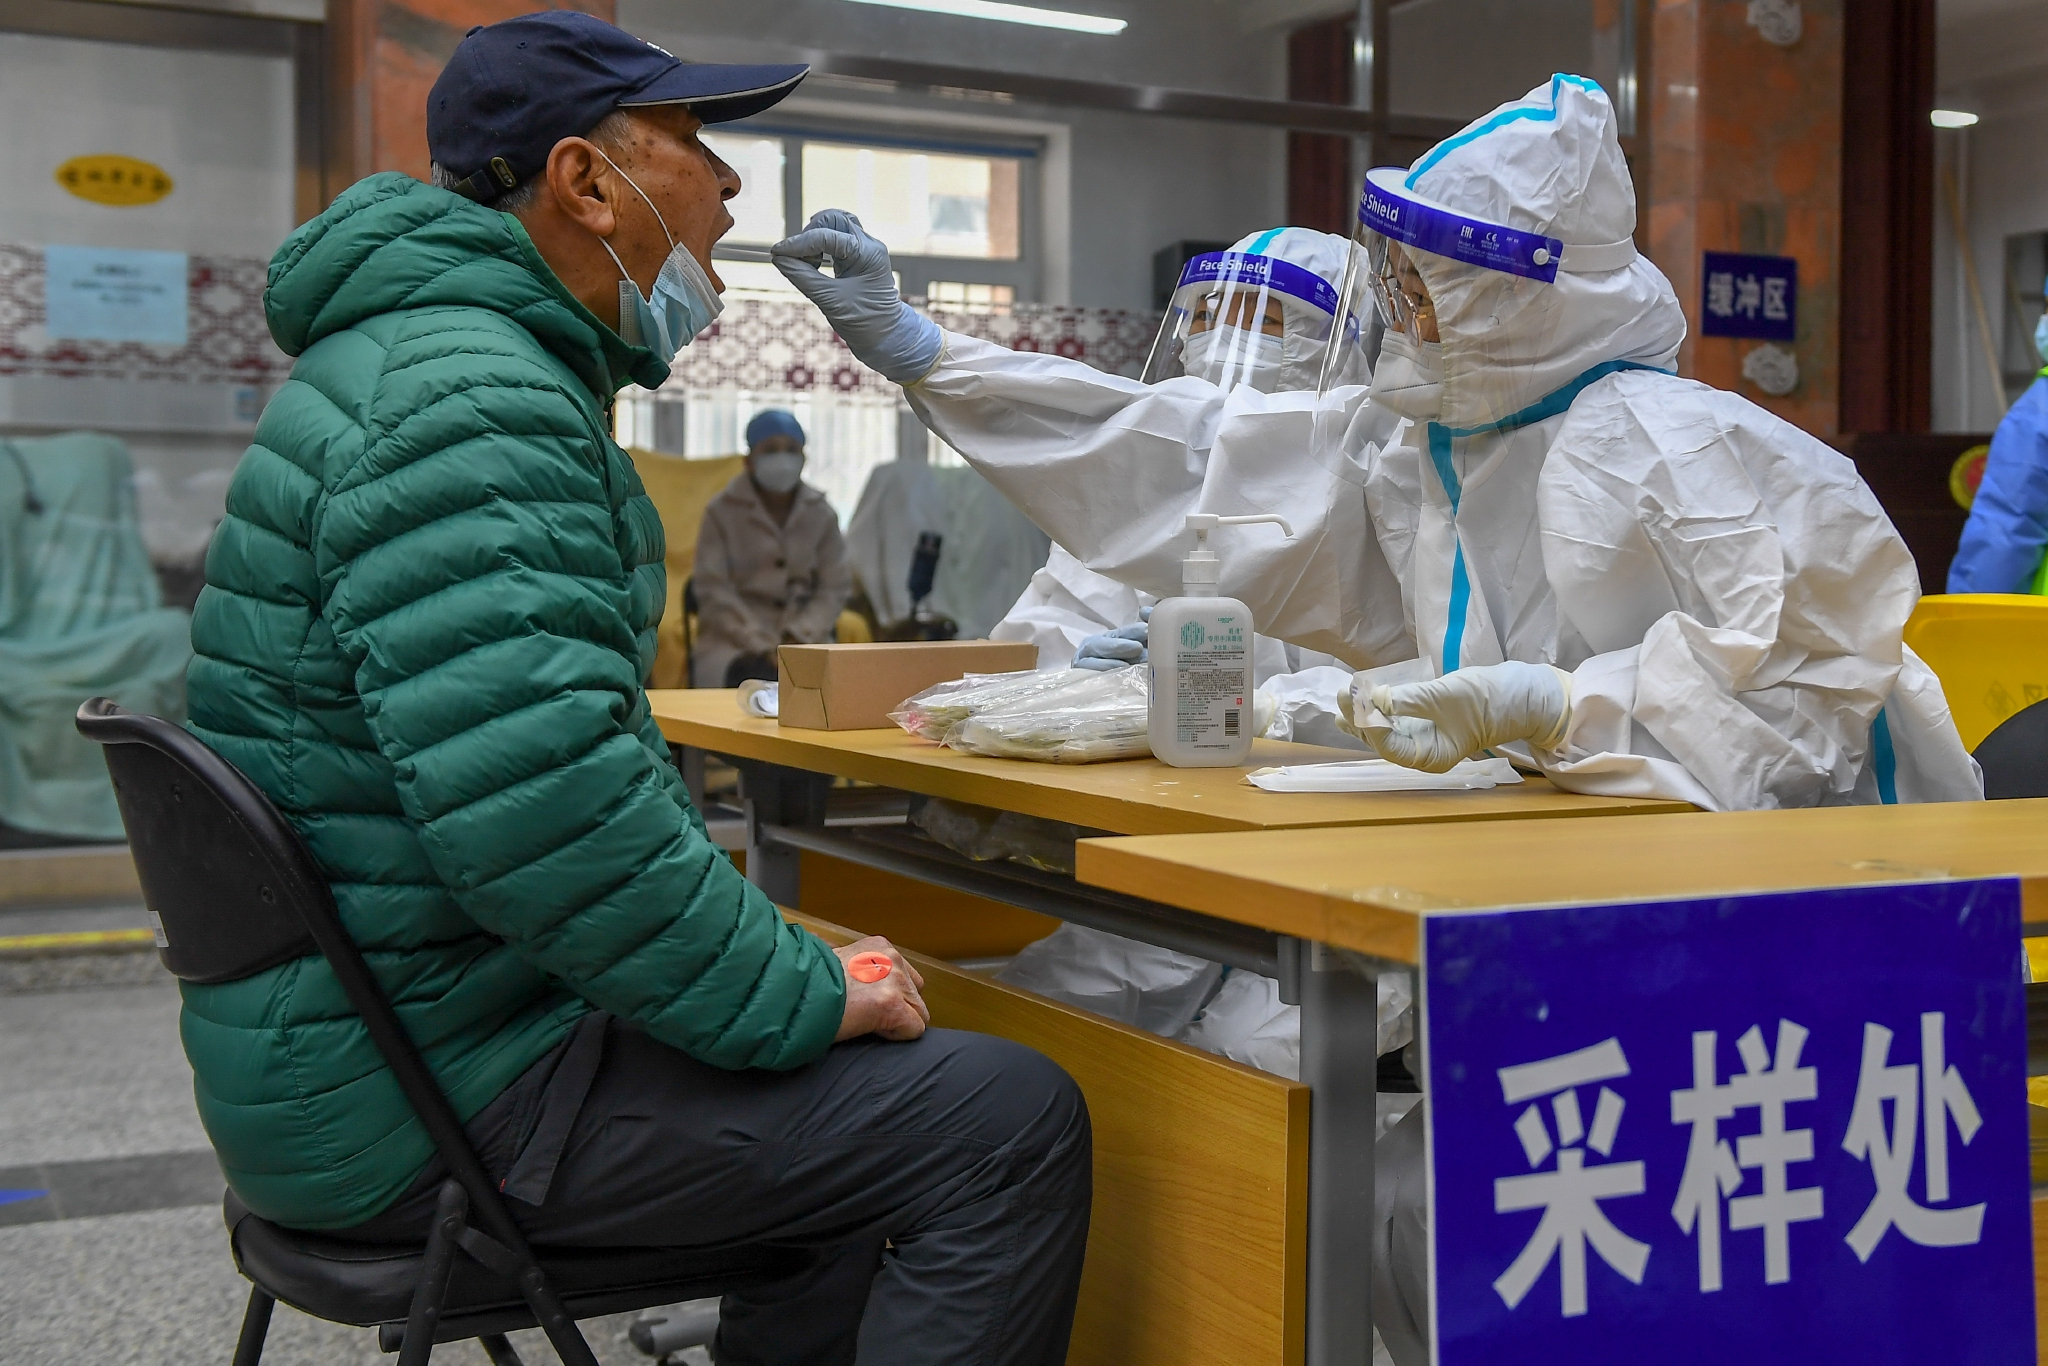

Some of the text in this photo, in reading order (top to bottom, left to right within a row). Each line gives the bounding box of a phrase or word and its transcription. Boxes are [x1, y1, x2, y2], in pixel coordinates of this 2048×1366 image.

[1367, 193, 1400, 223] Shield
[1199, 259, 1269, 275] Face Shield
[1708, 272, 1788, 320] 缓冲区
[1492, 1011, 1988, 1318] 采样处
